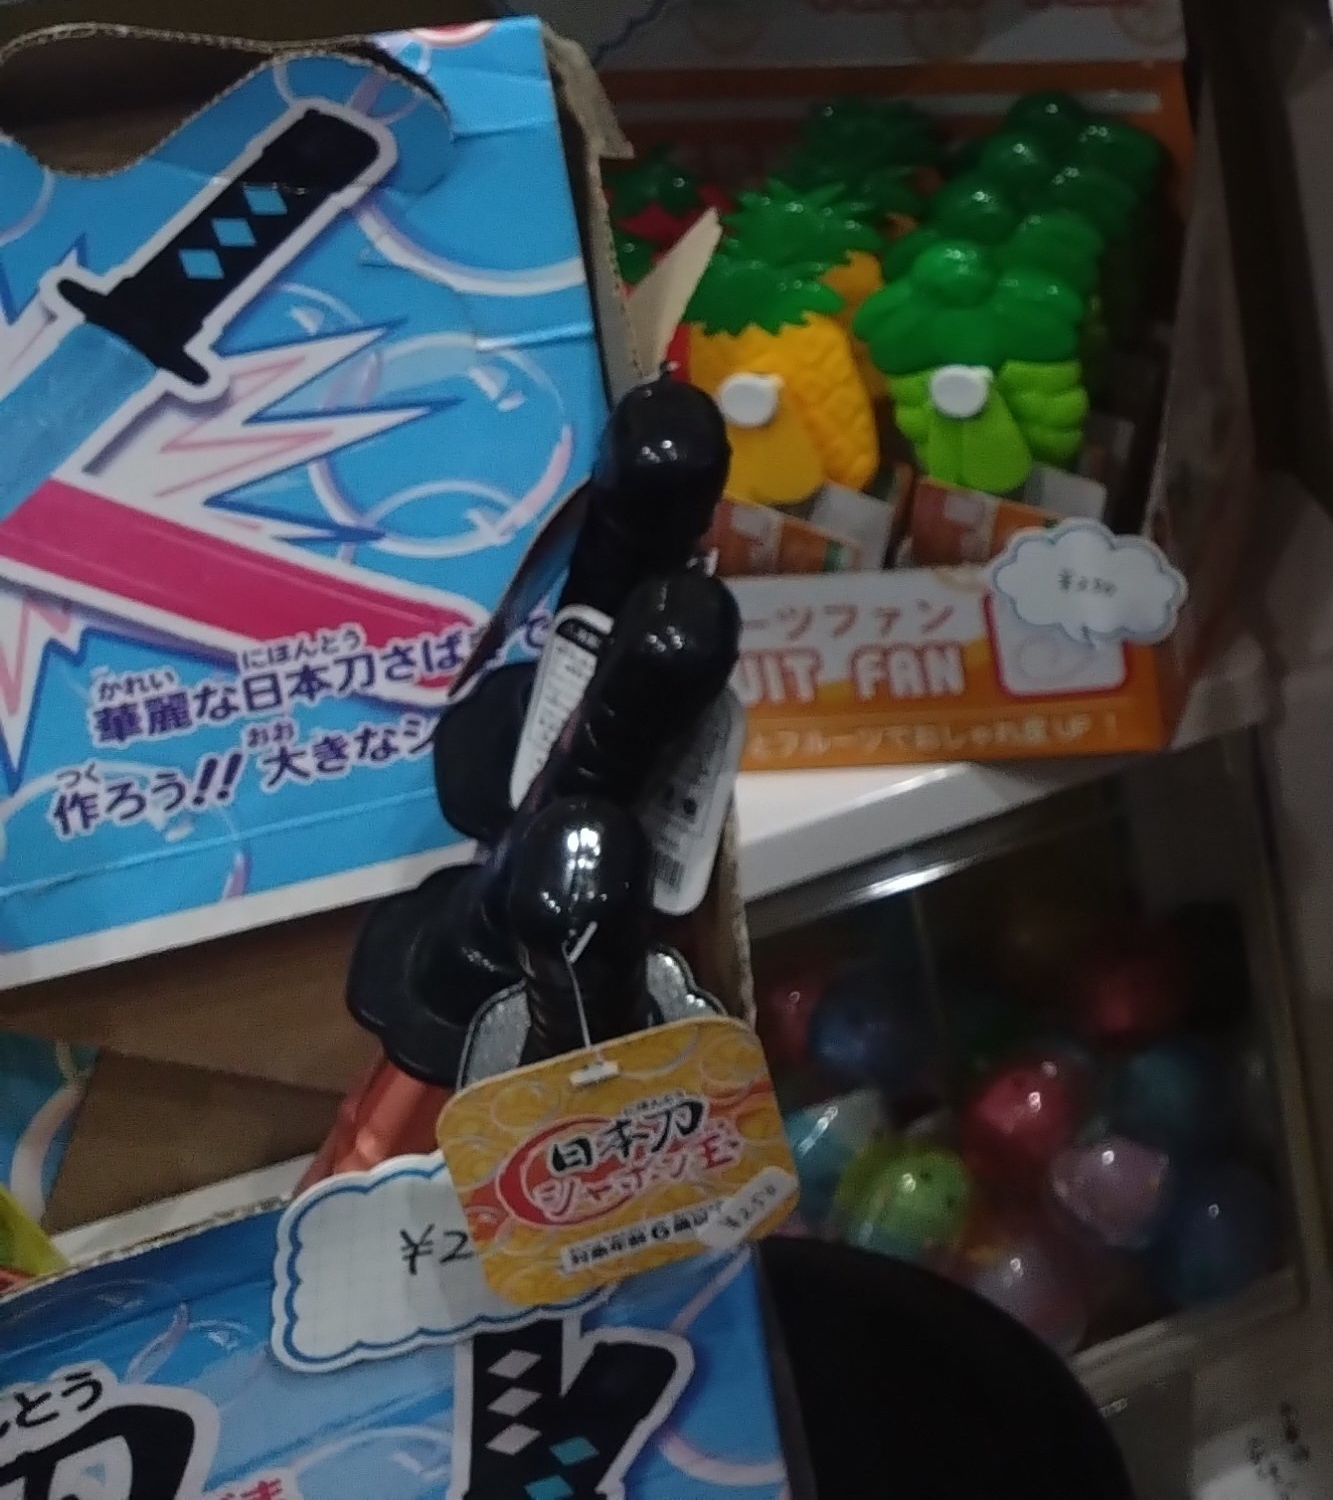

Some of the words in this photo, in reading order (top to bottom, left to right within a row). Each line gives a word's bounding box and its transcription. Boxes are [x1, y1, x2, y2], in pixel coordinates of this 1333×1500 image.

[96, 670, 177, 700] かれい
[850, 641, 967, 702] FAN
[245, 720, 298, 748] おお
[56, 762, 99, 787] つく
[549, 1098, 705, 1172] 日本刀
